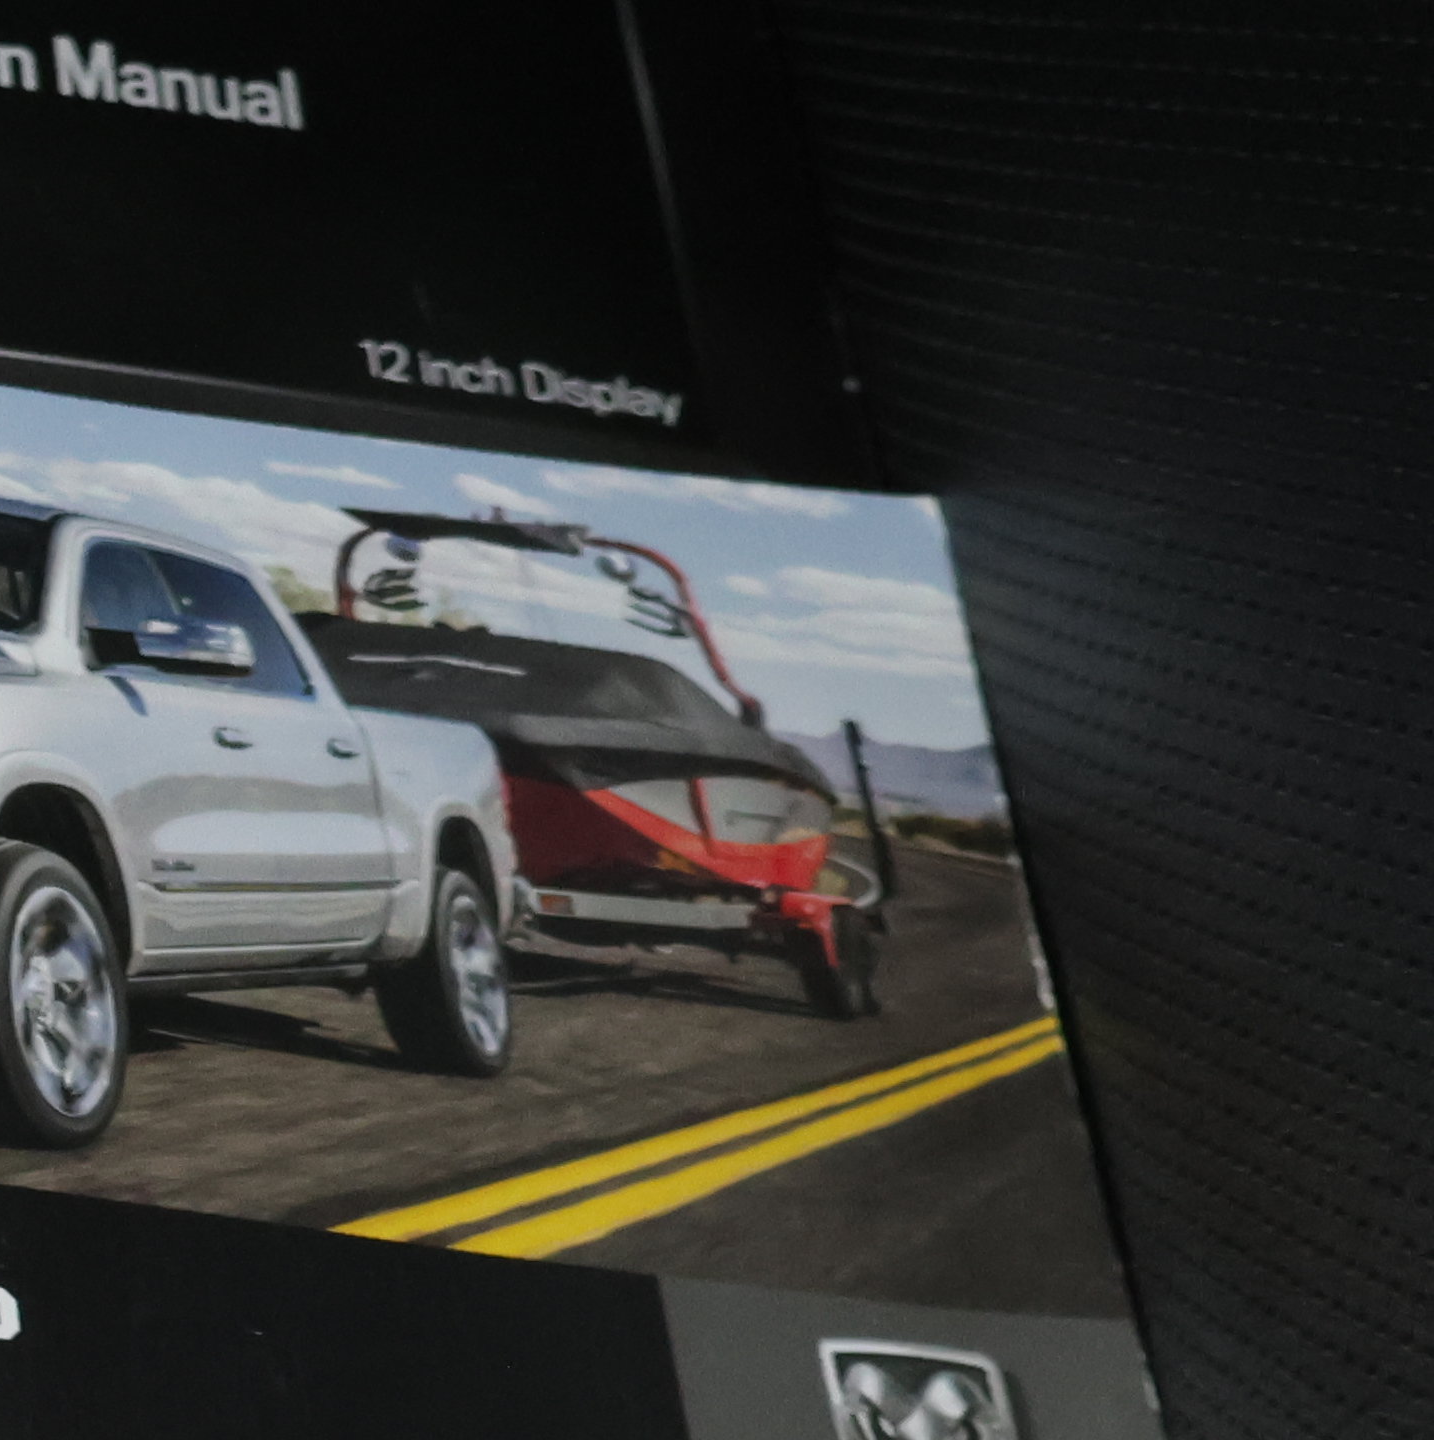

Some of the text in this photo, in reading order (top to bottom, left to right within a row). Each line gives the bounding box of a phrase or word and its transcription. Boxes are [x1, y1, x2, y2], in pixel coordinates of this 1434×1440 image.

[52, 36, 304, 130] Manual
[357, 338, 683, 427] 12 inch Display
